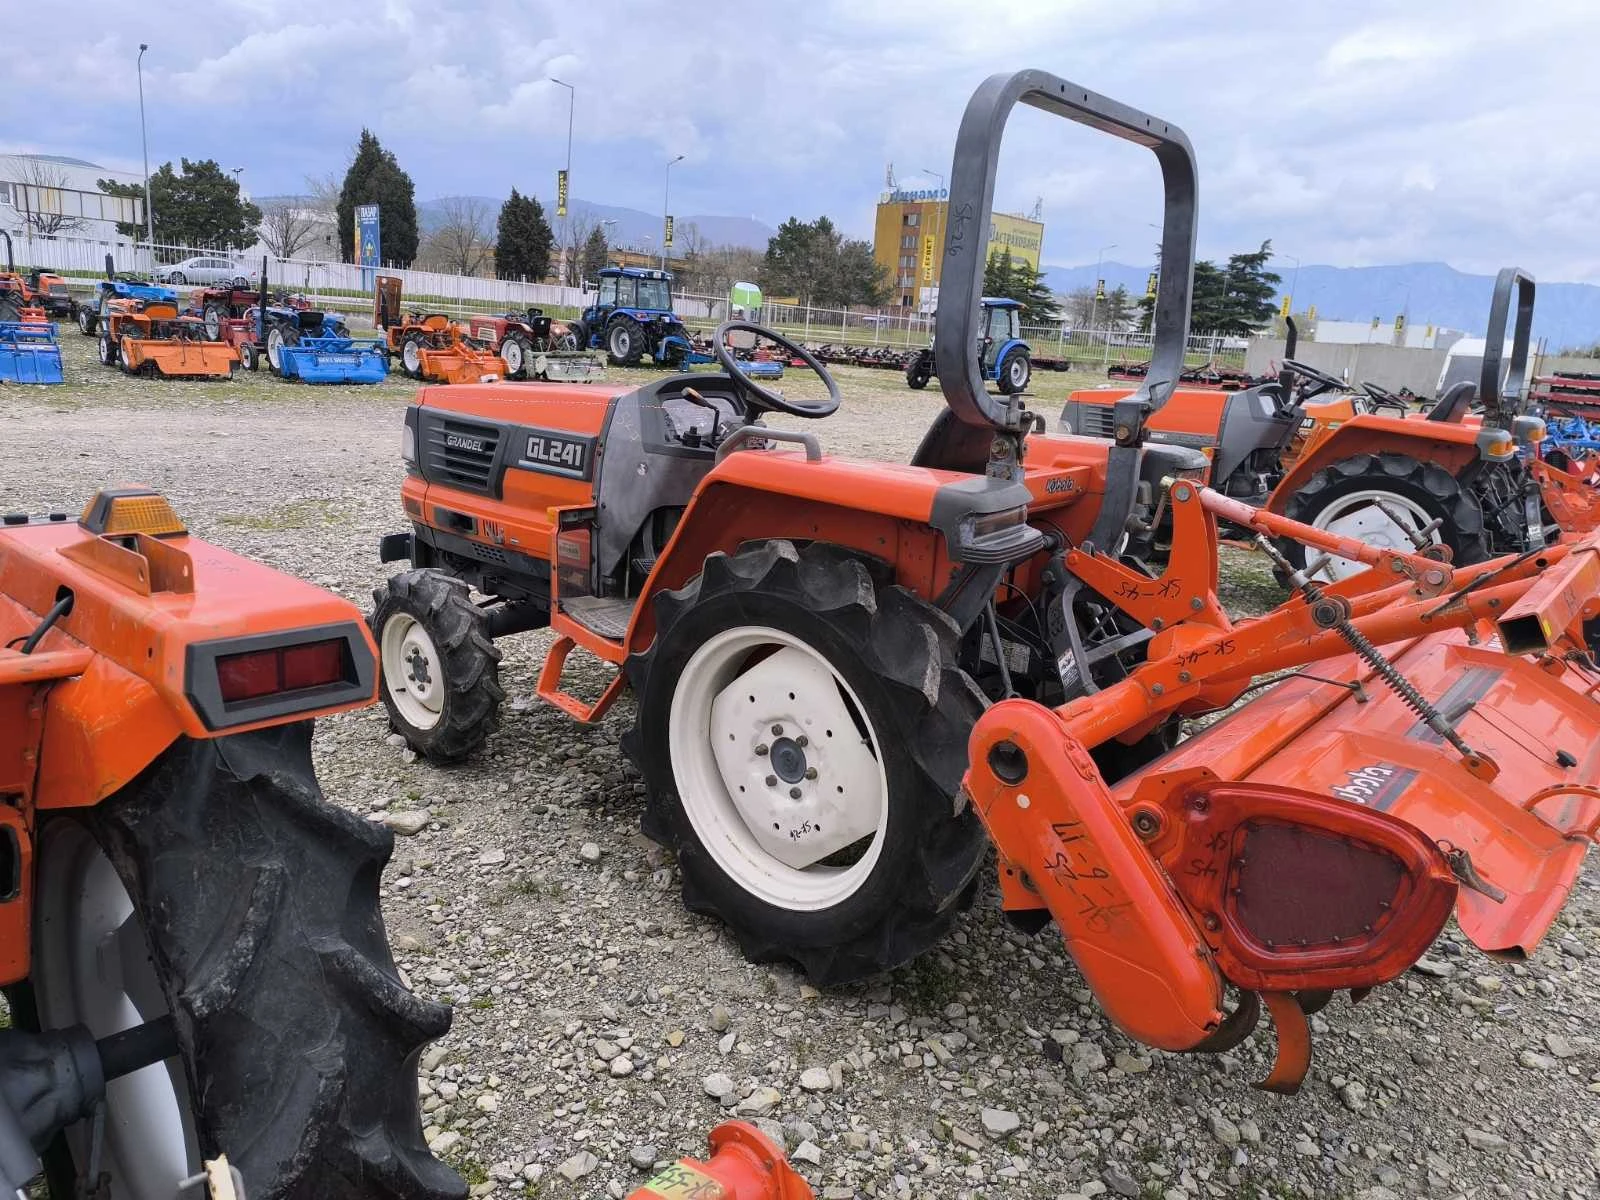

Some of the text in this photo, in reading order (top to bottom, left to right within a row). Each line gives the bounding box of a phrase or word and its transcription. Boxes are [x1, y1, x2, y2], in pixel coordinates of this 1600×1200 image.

[447, 435, 483, 452] GRANDEL
[526, 437, 583, 467] GL241
[1332, 766, 1394, 805] ubota
